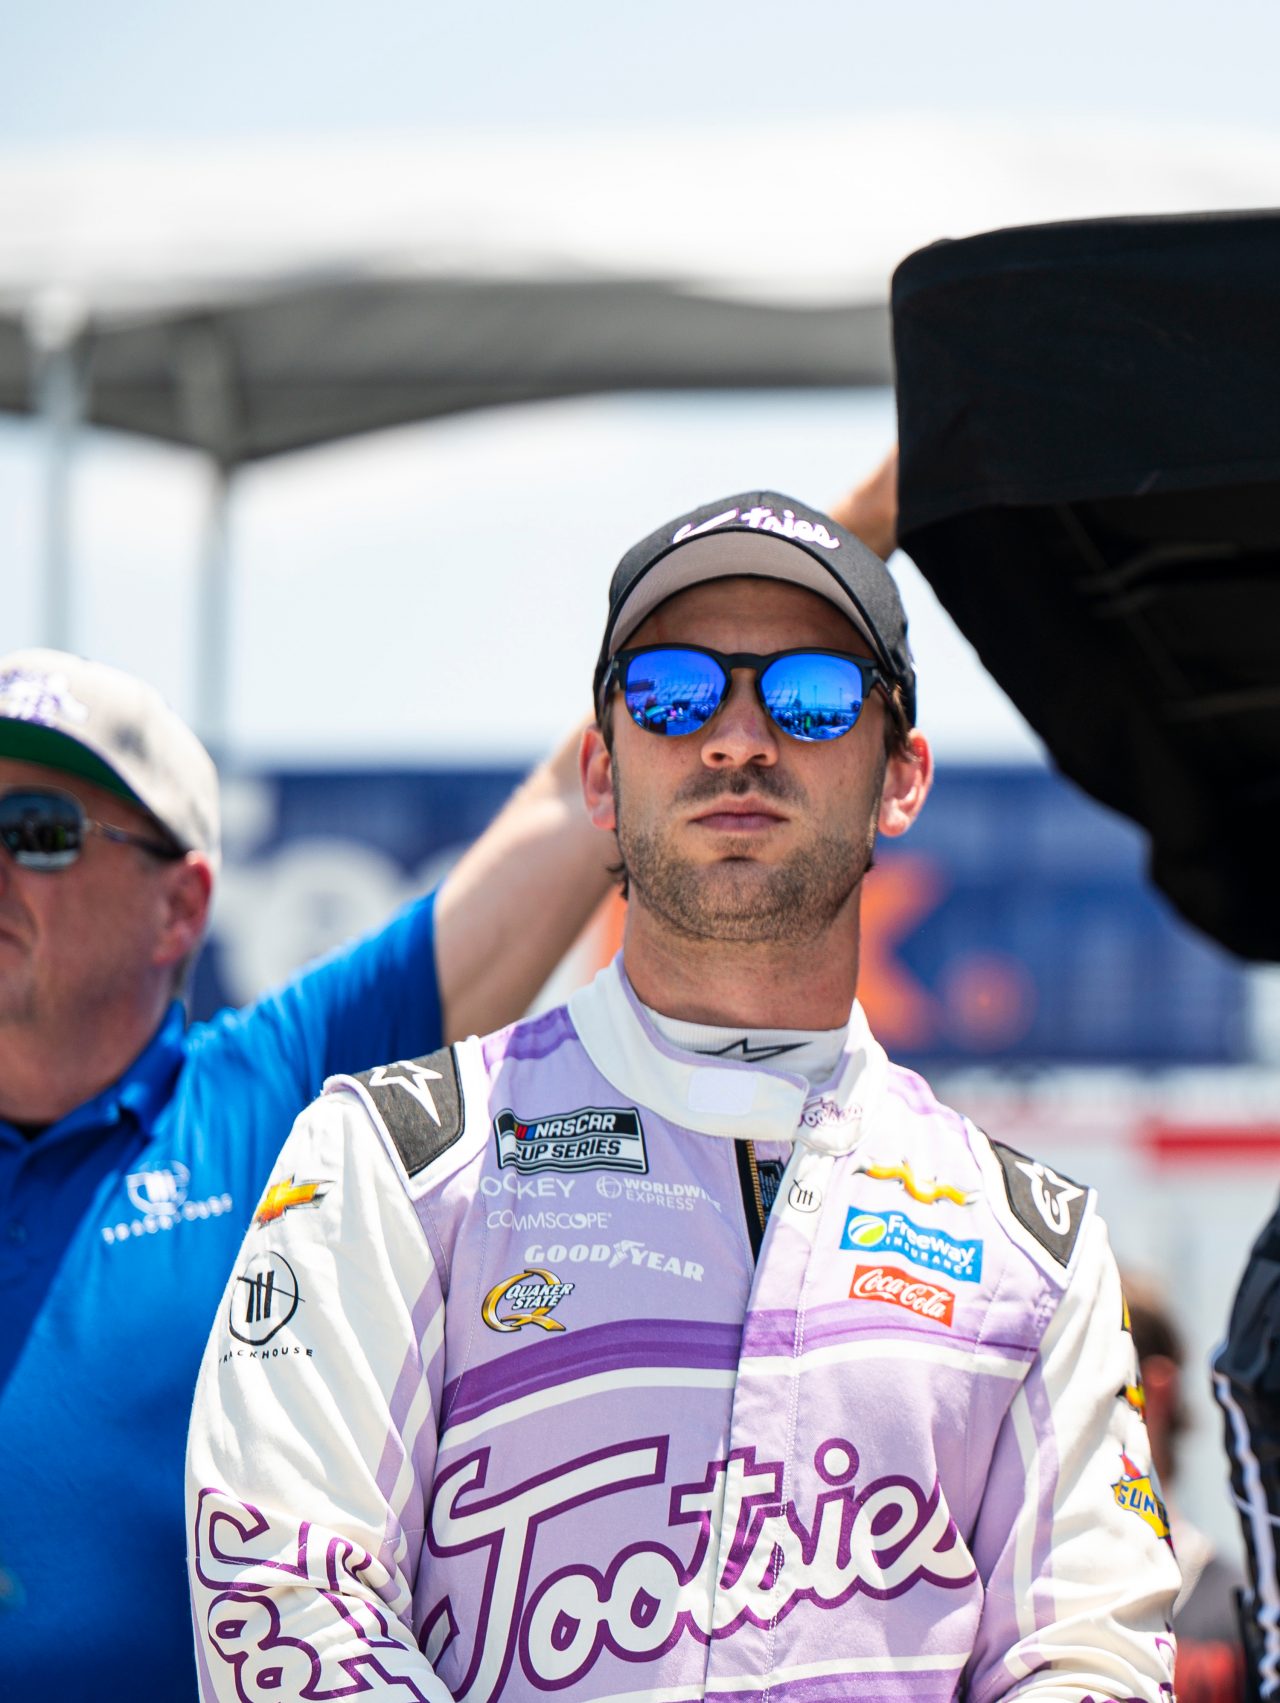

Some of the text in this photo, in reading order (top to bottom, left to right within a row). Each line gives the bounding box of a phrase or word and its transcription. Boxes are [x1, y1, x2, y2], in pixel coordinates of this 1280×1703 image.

[534, 1113, 617, 1139] NASCAR
[551, 1139, 622, 1160] SERIES
[462, 1172, 576, 1200] OCKEY
[625, 1190, 696, 1212] EXPRESS
[887, 1214, 976, 1267] Freeway
[523, 1243, 705, 1283] GOODYEAR
[885, 1236, 973, 1275] INSURANCE
[504, 1283, 576, 1300] QUAKER
[512, 1295, 561, 1310] STATE
